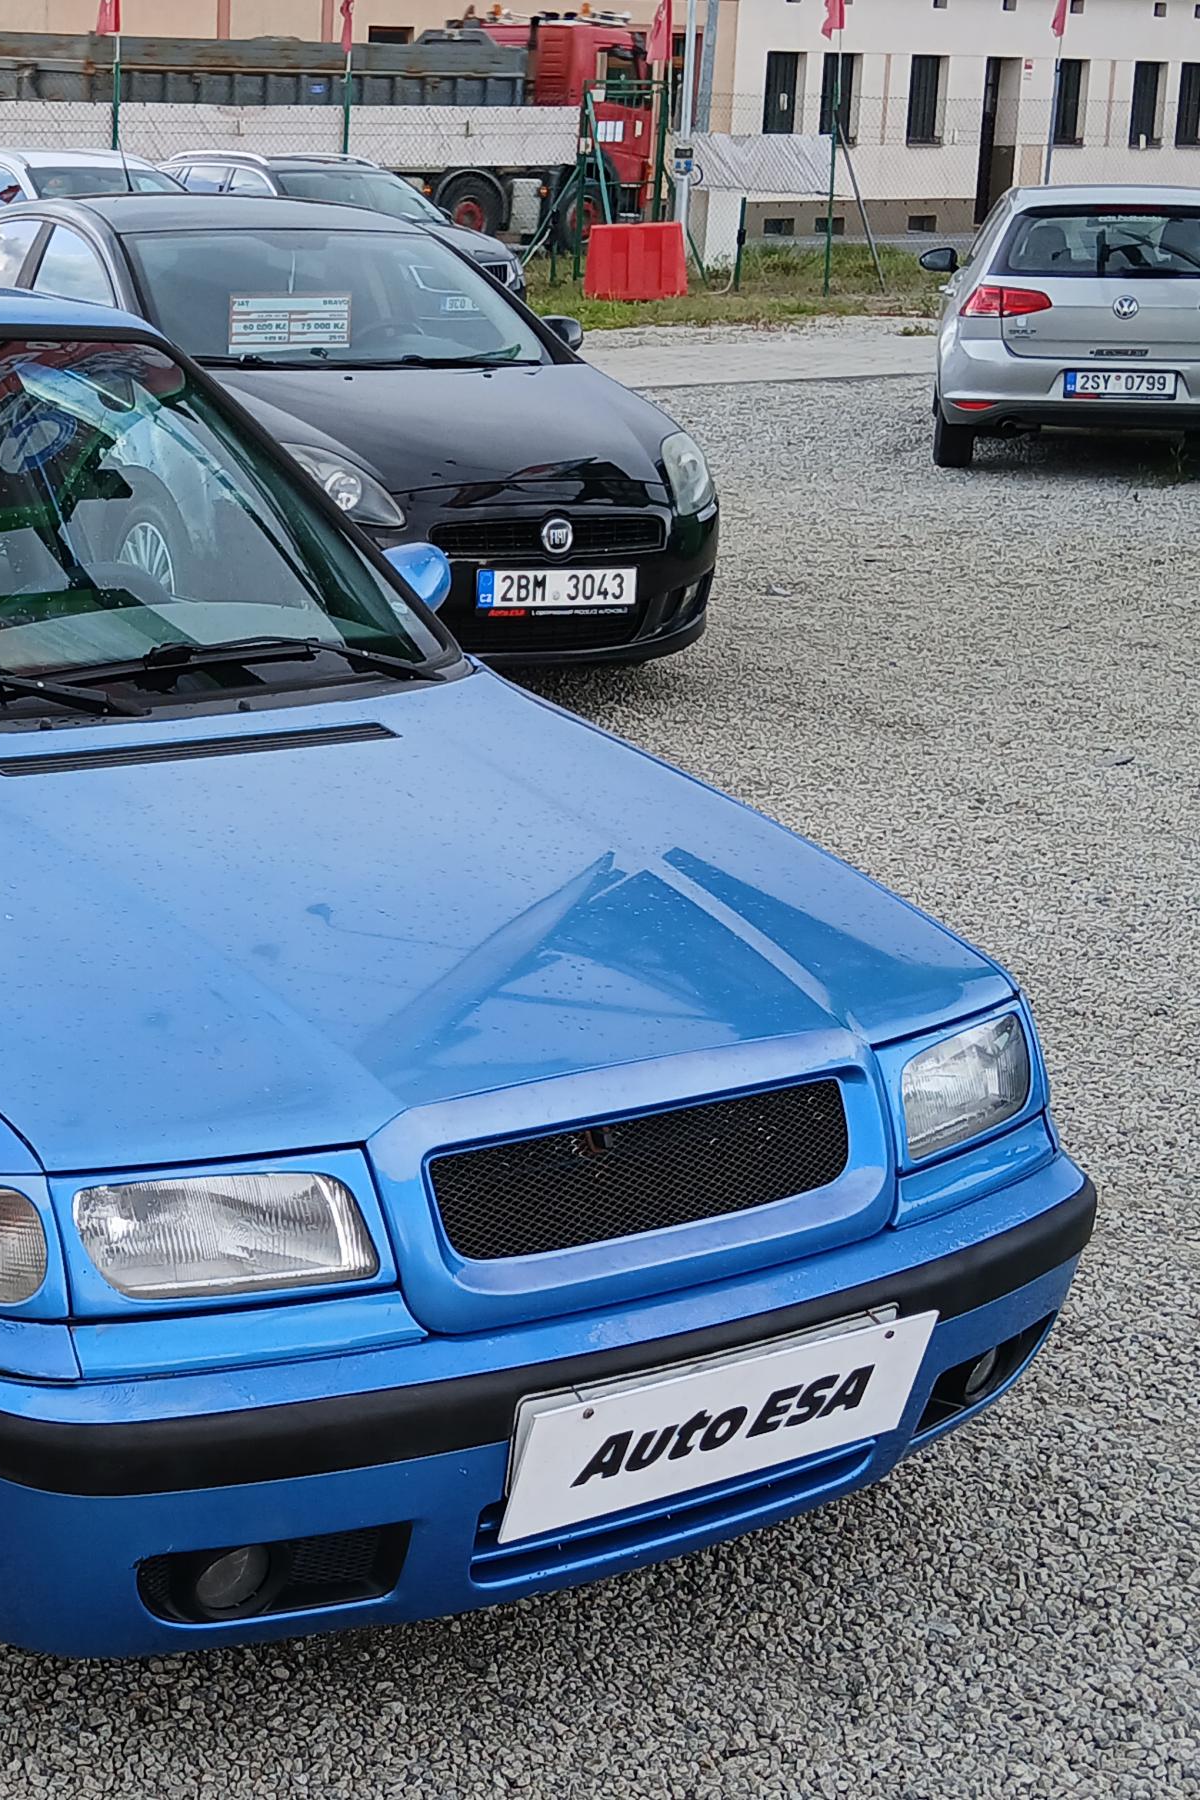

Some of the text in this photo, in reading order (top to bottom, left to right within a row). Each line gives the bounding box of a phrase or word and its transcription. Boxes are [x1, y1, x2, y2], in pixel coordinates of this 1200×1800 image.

[314, 322, 330, 330] 000
[1080, 375, 1111, 391] 2SY
[1125, 375, 1167, 391] 0799
[550, 529, 567, 546] FIAT
[501, 574, 547, 602] 2BM
[566, 573, 625, 601] 3043
[570, 1363, 875, 1487] Auto ESA
